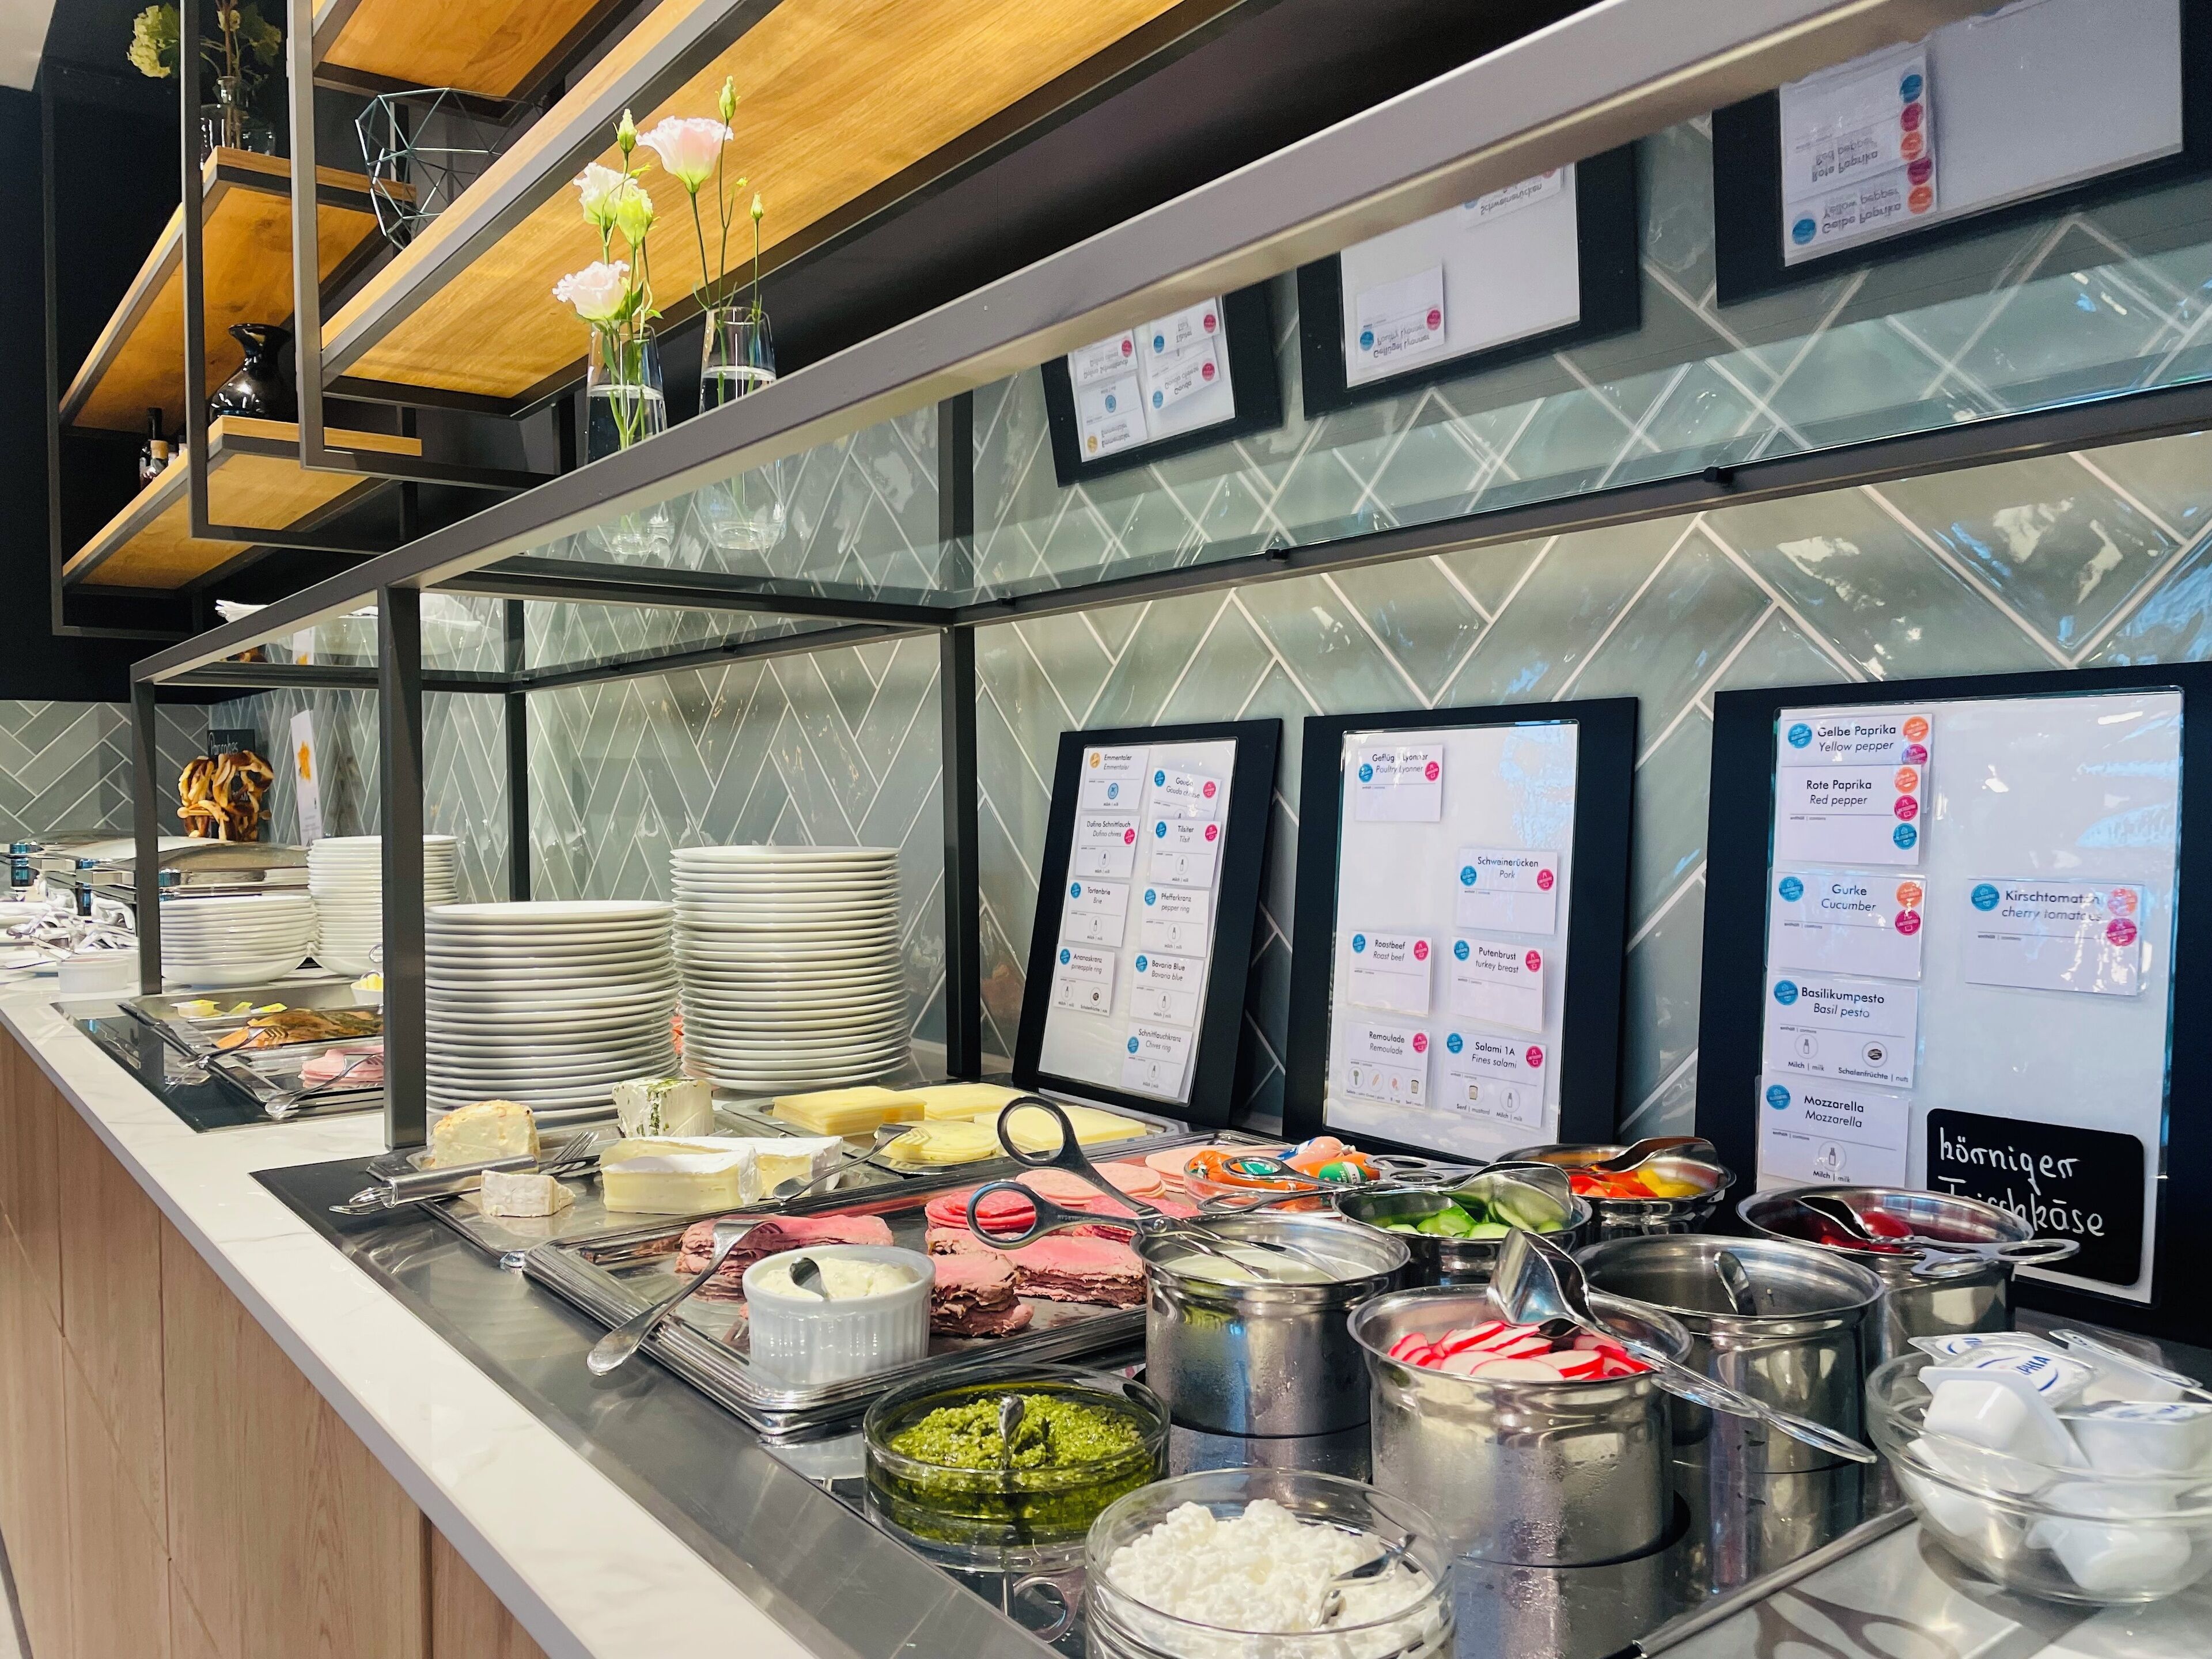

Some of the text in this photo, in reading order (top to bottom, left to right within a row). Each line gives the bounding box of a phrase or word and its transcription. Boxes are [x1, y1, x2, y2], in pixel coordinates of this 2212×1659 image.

[1817, 726, 1851, 737] Gelbe
[1854, 724, 1896, 738] Paprika
[1819, 741, 1894, 753] Yellow pepper
[1104, 753, 1132, 762] Emmentaler
[1372, 753, 1397, 763] Geflüg
[1376, 764, 1423, 774] Poultry Lyonner
[1806, 779, 1872, 791] Rote Paprika
[1166, 785, 1200, 798] Gouda chese
[1809, 794, 1868, 807] Red pepper
[1478, 857, 1539, 868] Schweinerücken
[1499, 870, 1516, 879] Pork
[1088, 887, 1111, 895] Tortenbrie
[1832, 884, 1867, 896] Gurke
[1161, 893, 1192, 902] Pfefferkranz
[2005, 891, 2100, 904] Kirschtomatn
[1180, 905, 1190, 913] ring
[1821, 898, 1876, 911] Cucumber
[2002, 907, 2040, 920] cherry
[1374, 939, 1406, 950] Roastbeef
[1073, 953, 1103, 963] Ananaskranz
[1373, 951, 1405, 961] Roast beef
[1479, 947, 1516, 960] Putenbrust
[1071, 964, 1103, 975] pineapple ring
[1152, 960, 1185, 971] Bavaria Blue
[1475, 960, 1518, 974] turkey breast
[1152, 971, 1183, 982] Bavaria blue
[1802, 987, 1885, 1004] Basilikumpesto
[1813, 1003, 1870, 1018] Basil pesto
[1138, 1029, 1181, 1043] Schnittlauchkranz
[1369, 1031, 1405, 1043] Remoulade
[1146, 1040, 1171, 1052] Chives ring
[1370, 1043, 1403, 1055] Remoulade
[1475, 1041, 1516, 1056] Salami 1A
[1472, 1054, 1517, 1069] Fines salami
[1839, 1067, 1889, 1080] Schalenfrüchte
[1804, 1095, 1864, 1112] Mozzarella
[1805, 1109, 1862, 1128] Mozzarella
[1940, 1127, 2081, 1196] körniger
[1813, 1170, 1831, 1179] Milch
